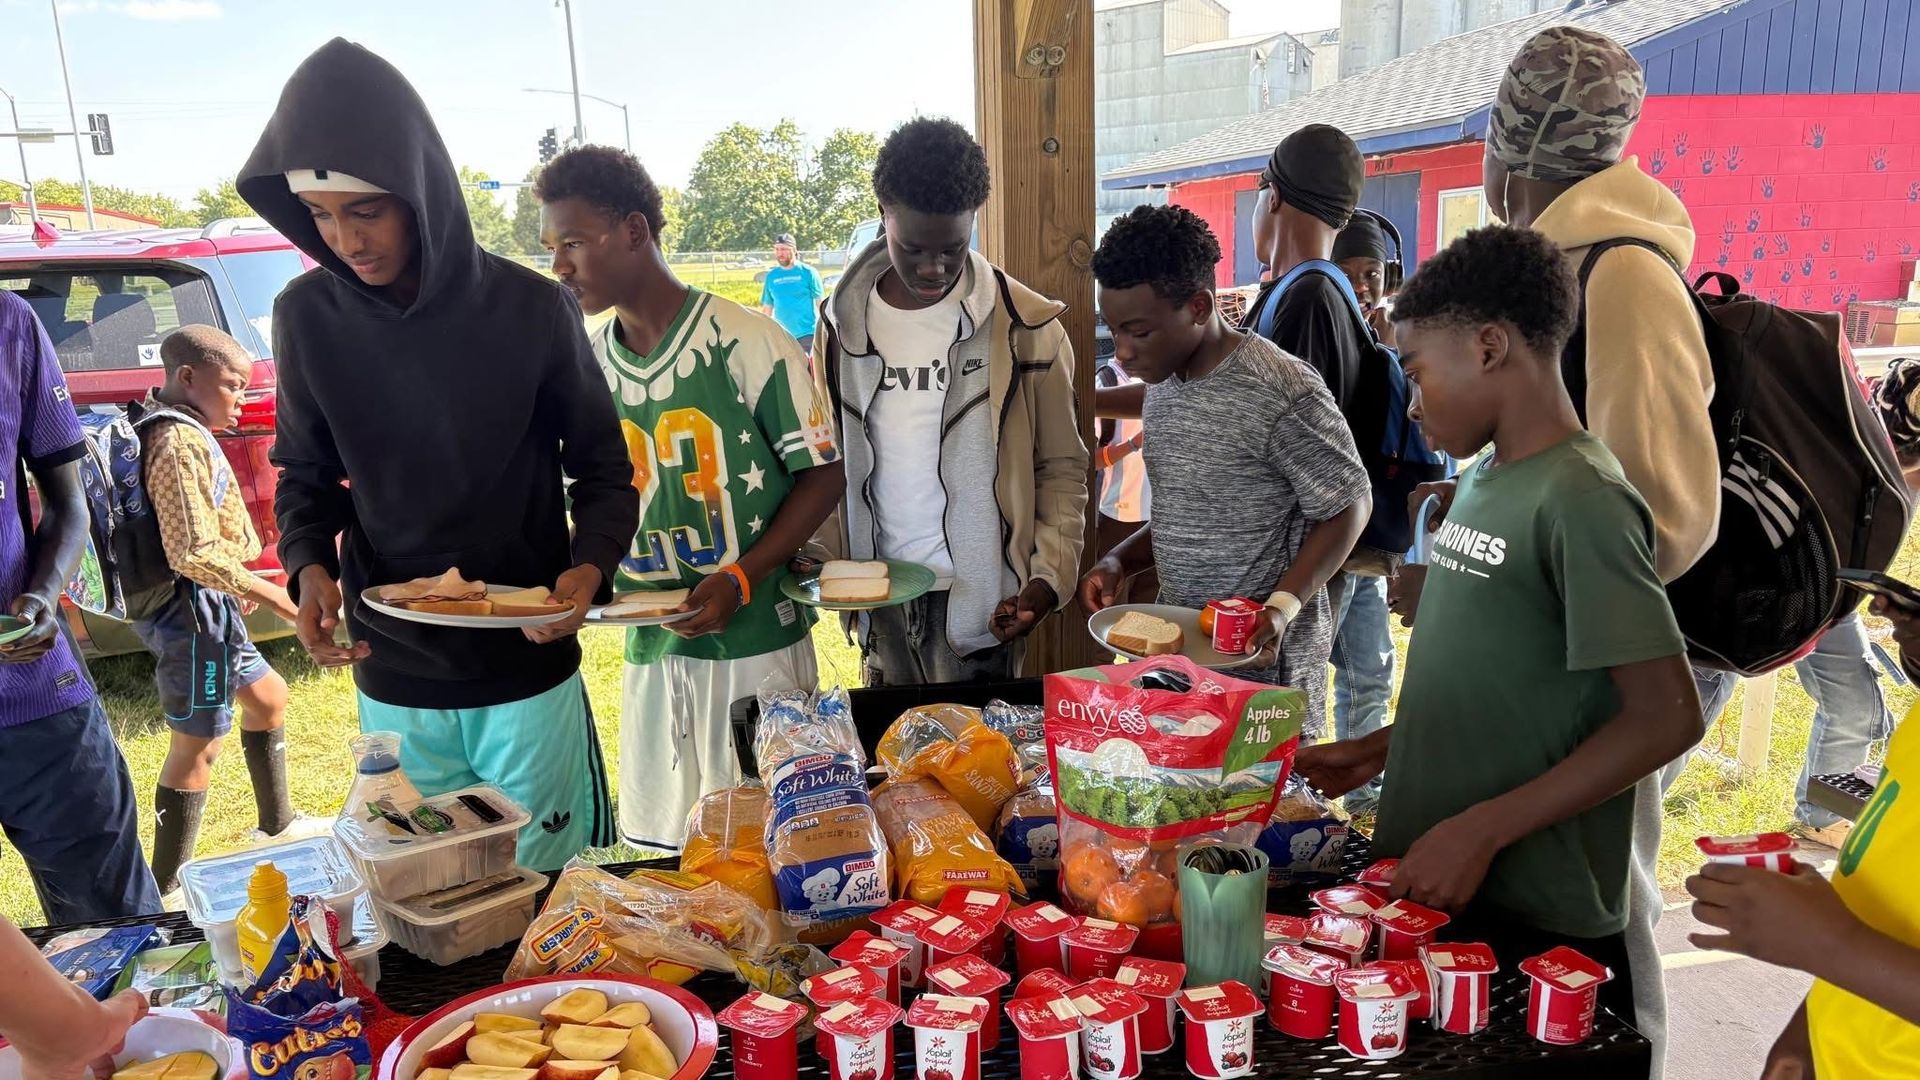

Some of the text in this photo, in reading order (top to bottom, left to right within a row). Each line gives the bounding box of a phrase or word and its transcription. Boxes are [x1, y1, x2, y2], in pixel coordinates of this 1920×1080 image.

[965, 359, 983, 368] NIKE
[1440, 556, 1459, 571] CLUB
[1058, 699, 1119, 737] envy
[1246, 705, 1291, 722] Apples
[1243, 727, 1271, 744] 4 lb
[794, 755, 832, 768] BIMBO
[777, 774, 806, 799] Soft
[810, 767, 859, 787] White
[845, 861, 875, 872] BIMBO
[946, 871, 988, 879] FAREWAY
[854, 872, 880, 893] Soft
[846, 889, 886, 905] White
[1374, 1012, 1399, 1023] Yoplait
[1223, 1029, 1247, 1043] Yoplait
[850, 1046, 876, 1060] Yoplait
[925, 1047, 953, 1060] Yoplait
[924, 1058, 952, 1067] Original
